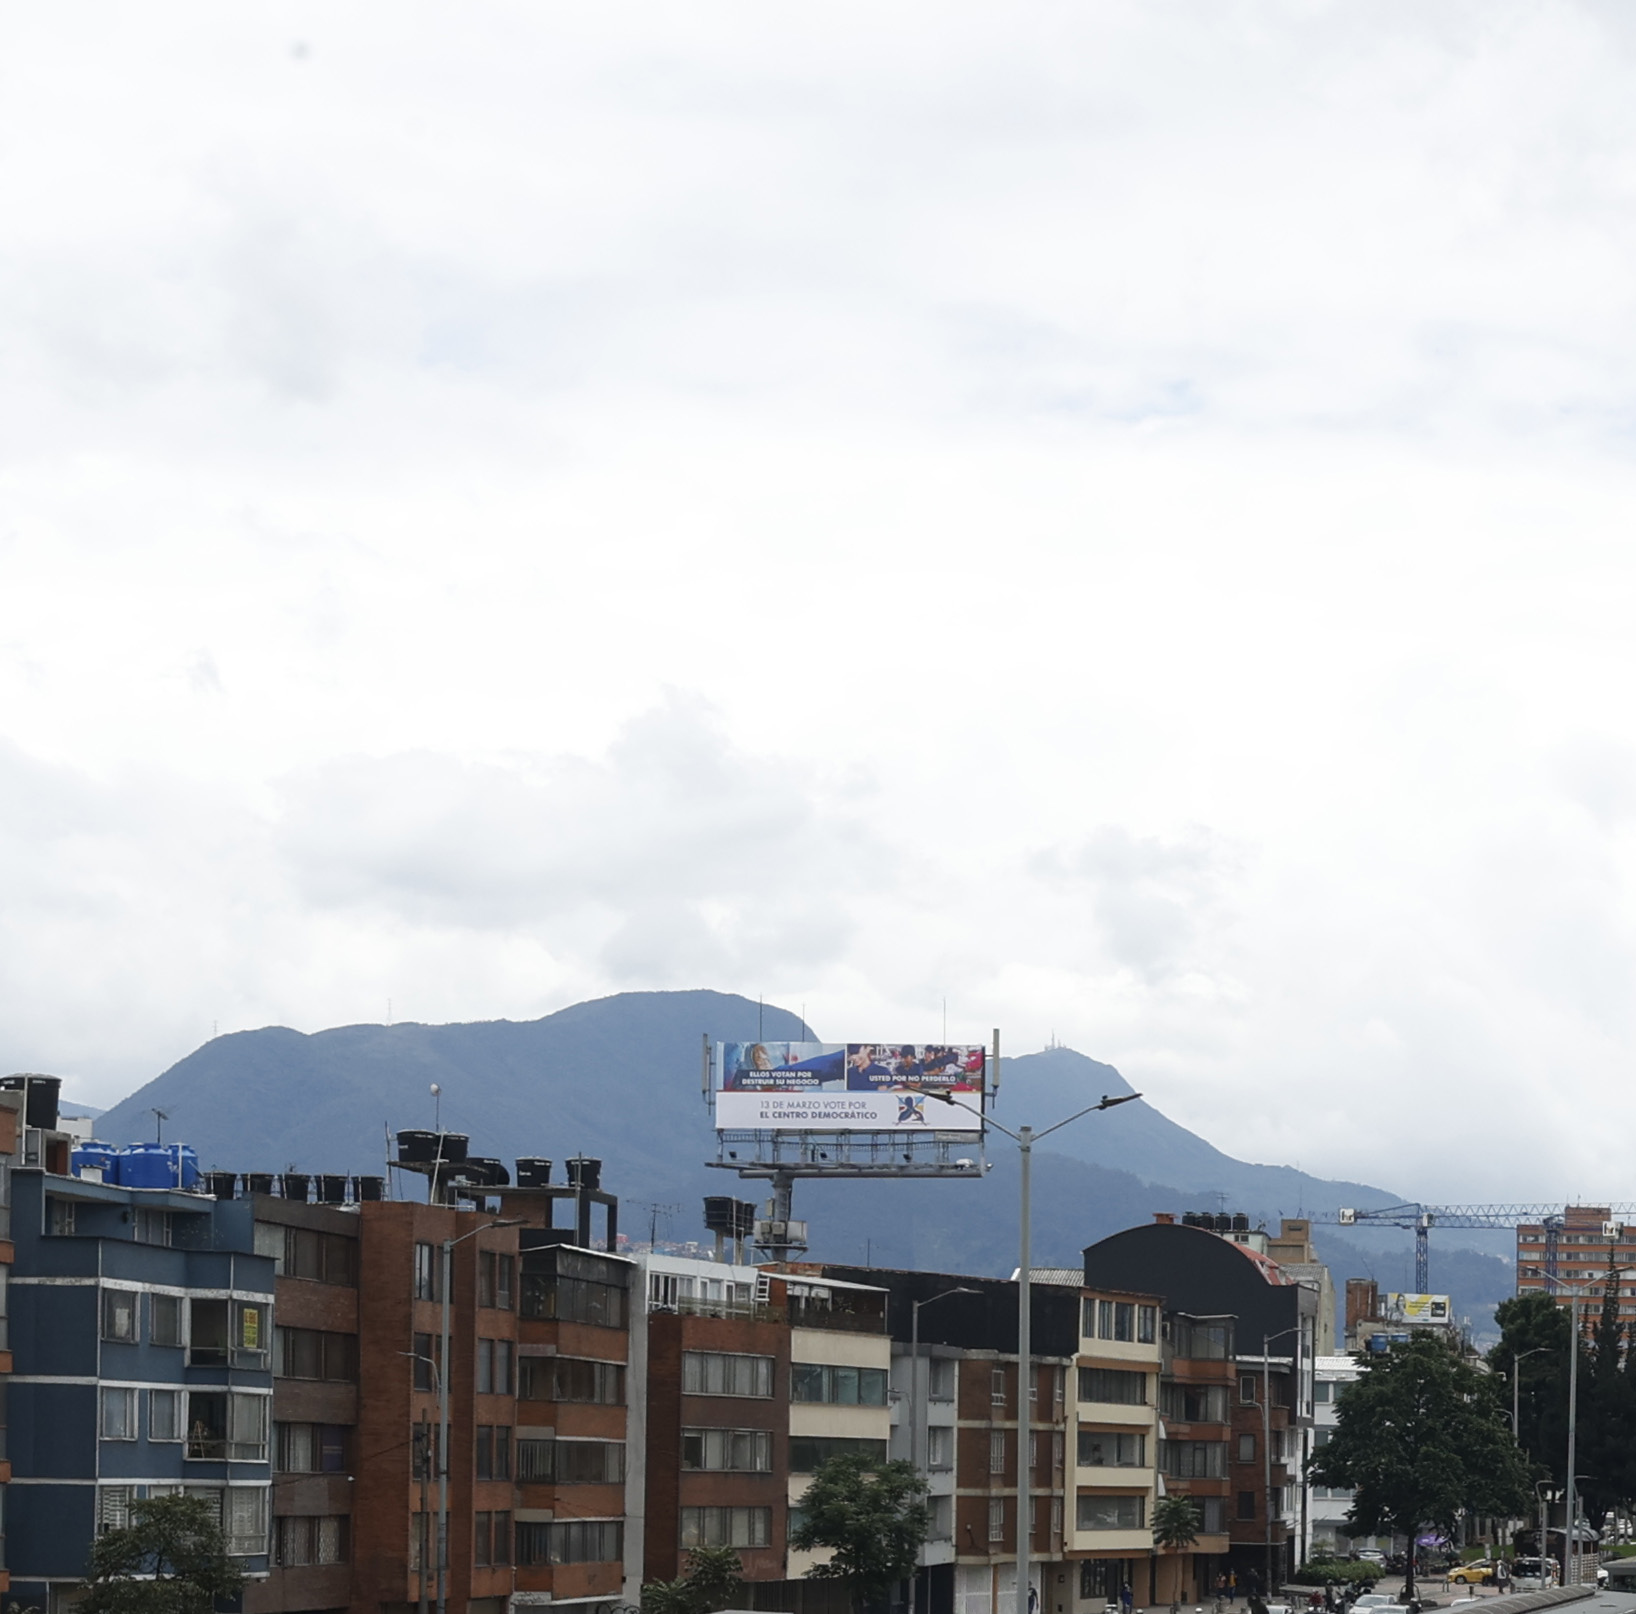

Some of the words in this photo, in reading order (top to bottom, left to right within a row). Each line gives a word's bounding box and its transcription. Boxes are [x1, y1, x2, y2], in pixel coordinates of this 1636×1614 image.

[760, 1101, 770, 1109] 13
[772, 1101, 784, 1109] DE
[787, 1101, 821, 1109] MARZO
[823, 1101, 847, 1109] VOTE
[848, 1101, 867, 1109] POR
[760, 1111, 770, 1119] EL
[772, 1111, 809, 1119] CENTRO
